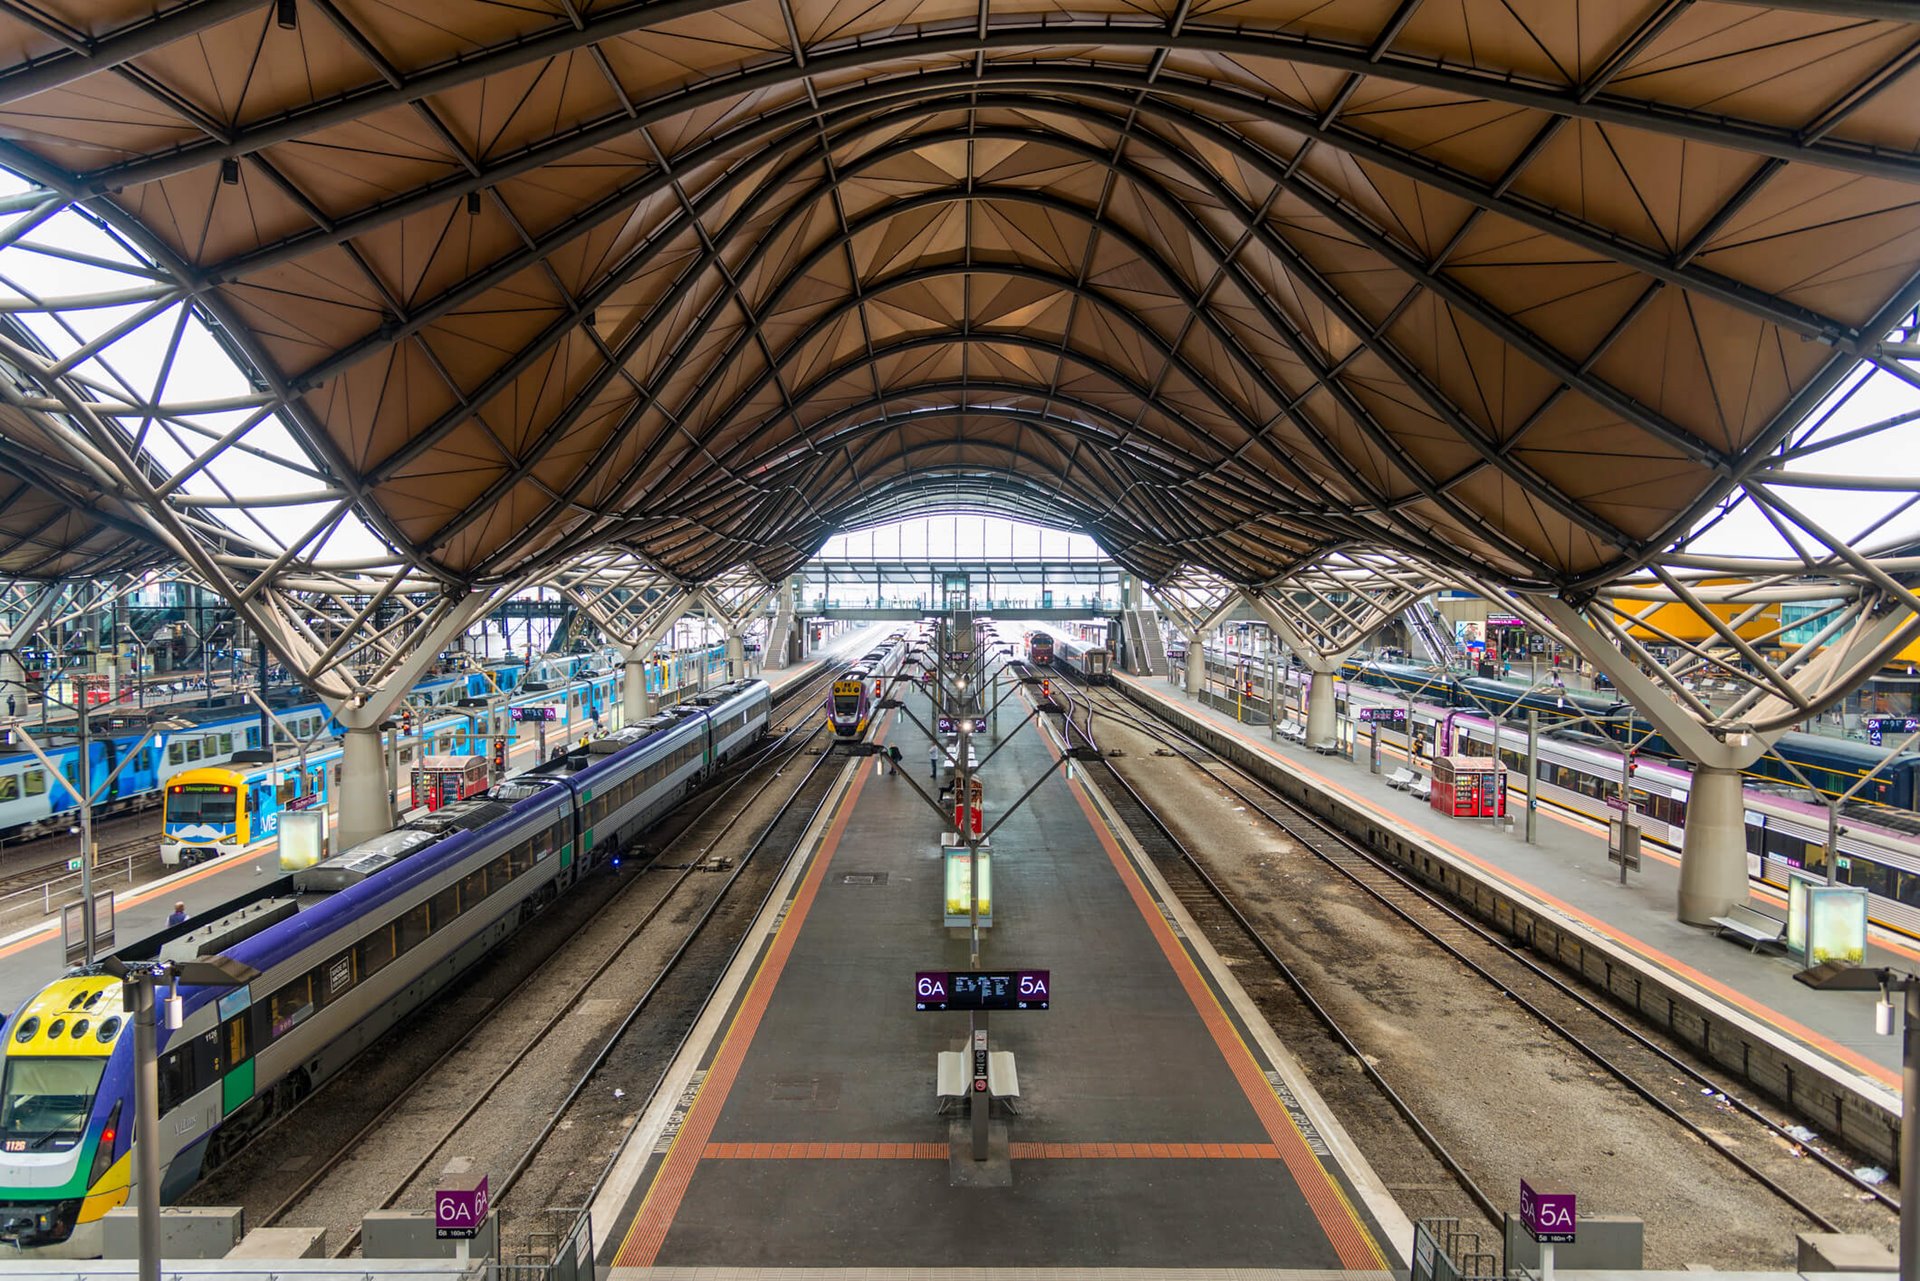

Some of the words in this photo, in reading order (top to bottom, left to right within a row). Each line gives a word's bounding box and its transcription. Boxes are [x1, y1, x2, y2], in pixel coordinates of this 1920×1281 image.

[512, 709, 522, 717] 8A
[1394, 709, 1404, 718] 3A
[940, 720, 950, 728] 6A
[1869, 720, 1879, 729] 2A
[1905, 720, 1916, 729] 2A
[918, 977, 945, 996] 6A
[1019, 976, 1047, 995] 5A
[660, 1122, 682, 1137] THE
[440, 1197, 471, 1220] 6A
[475, 1190, 487, 1216] 6A
[1522, 1190, 1536, 1224] 5A
[1540, 1203, 1572, 1226] 5A
